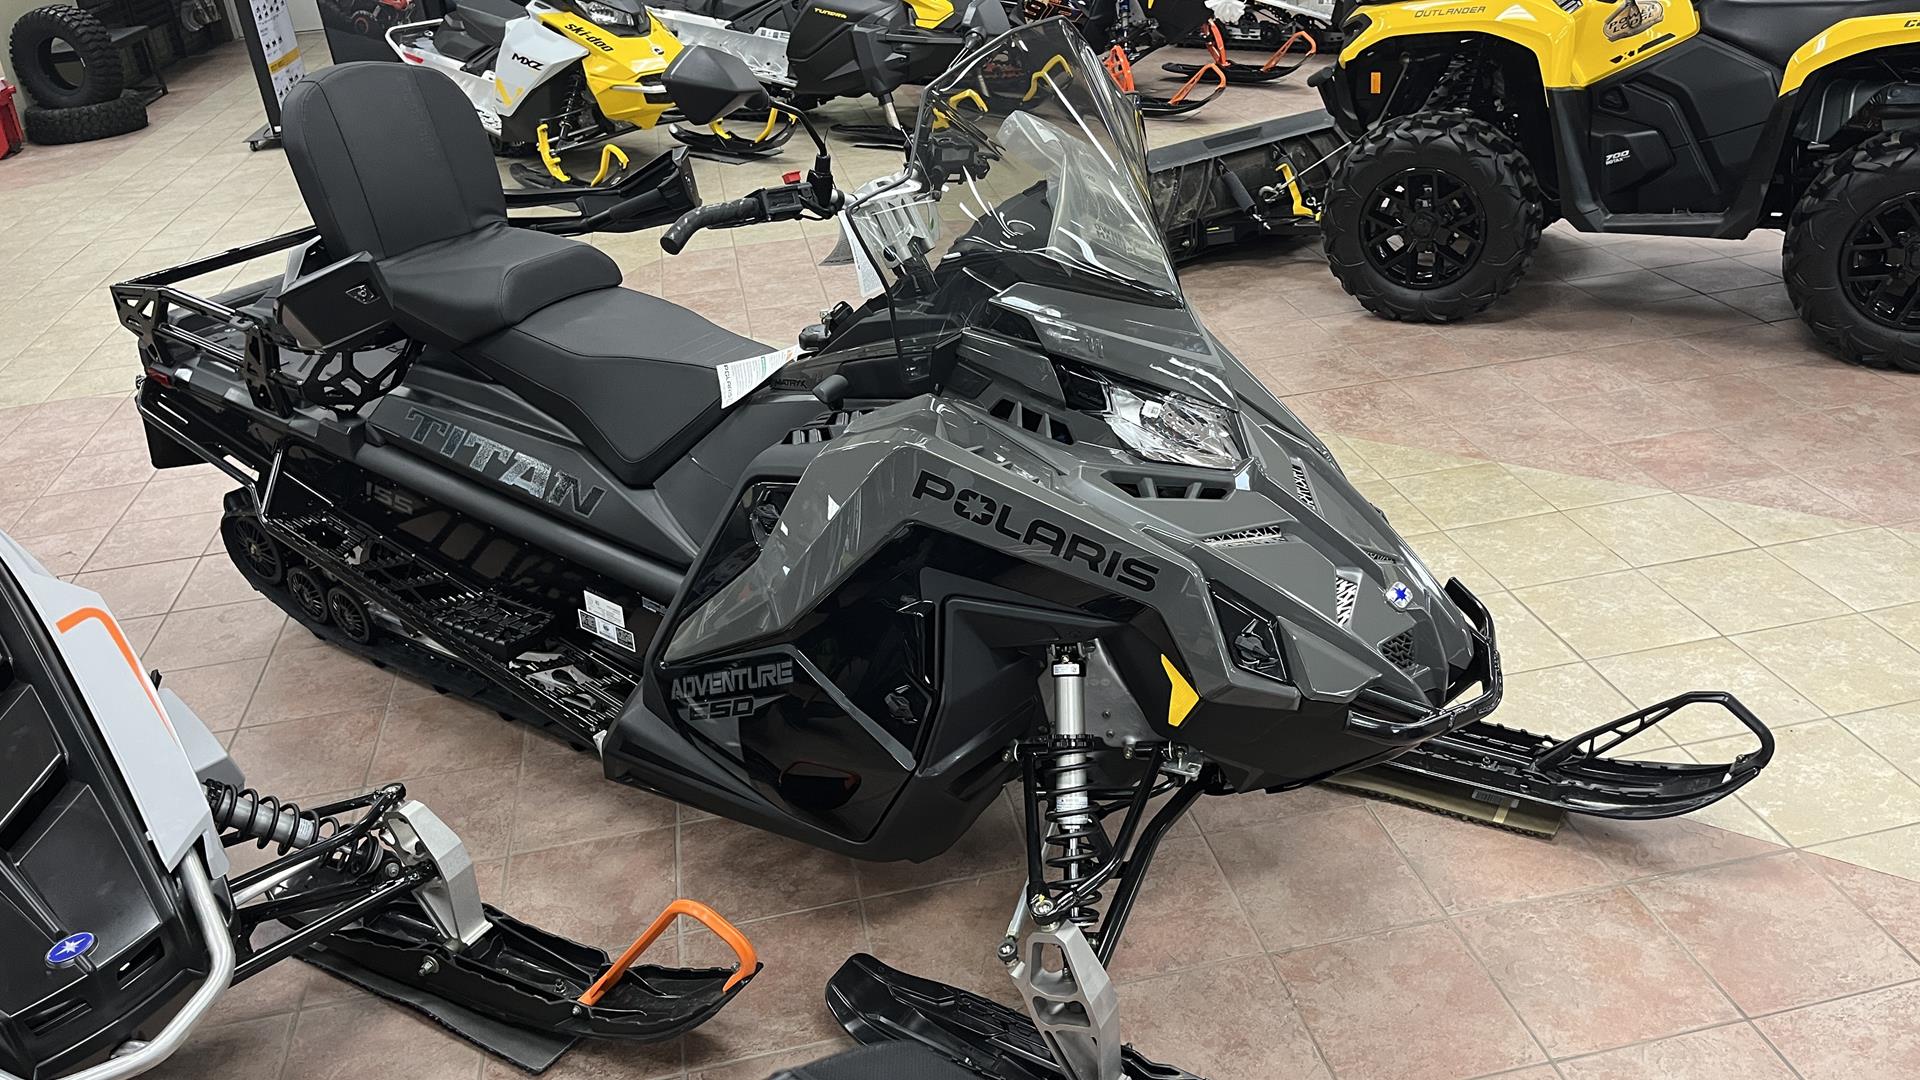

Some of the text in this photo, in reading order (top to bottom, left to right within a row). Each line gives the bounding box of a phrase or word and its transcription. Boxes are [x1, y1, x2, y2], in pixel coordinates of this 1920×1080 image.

[814, 7, 848, 20] TUNDRA
[1414, 6, 1487, 18] OUTLANDER
[1608, 4, 1656, 30] POWER
[1612, 12, 1654, 33] LODGE
[564, 23, 614, 53] ski-doo
[511, 53, 545, 71] MXZ
[1605, 149, 1630, 161] 700
[404, 406, 607, 519] TITAN
[911, 469, 1161, 593] POLARIS
[671, 661, 795, 701] ADVENTURE
